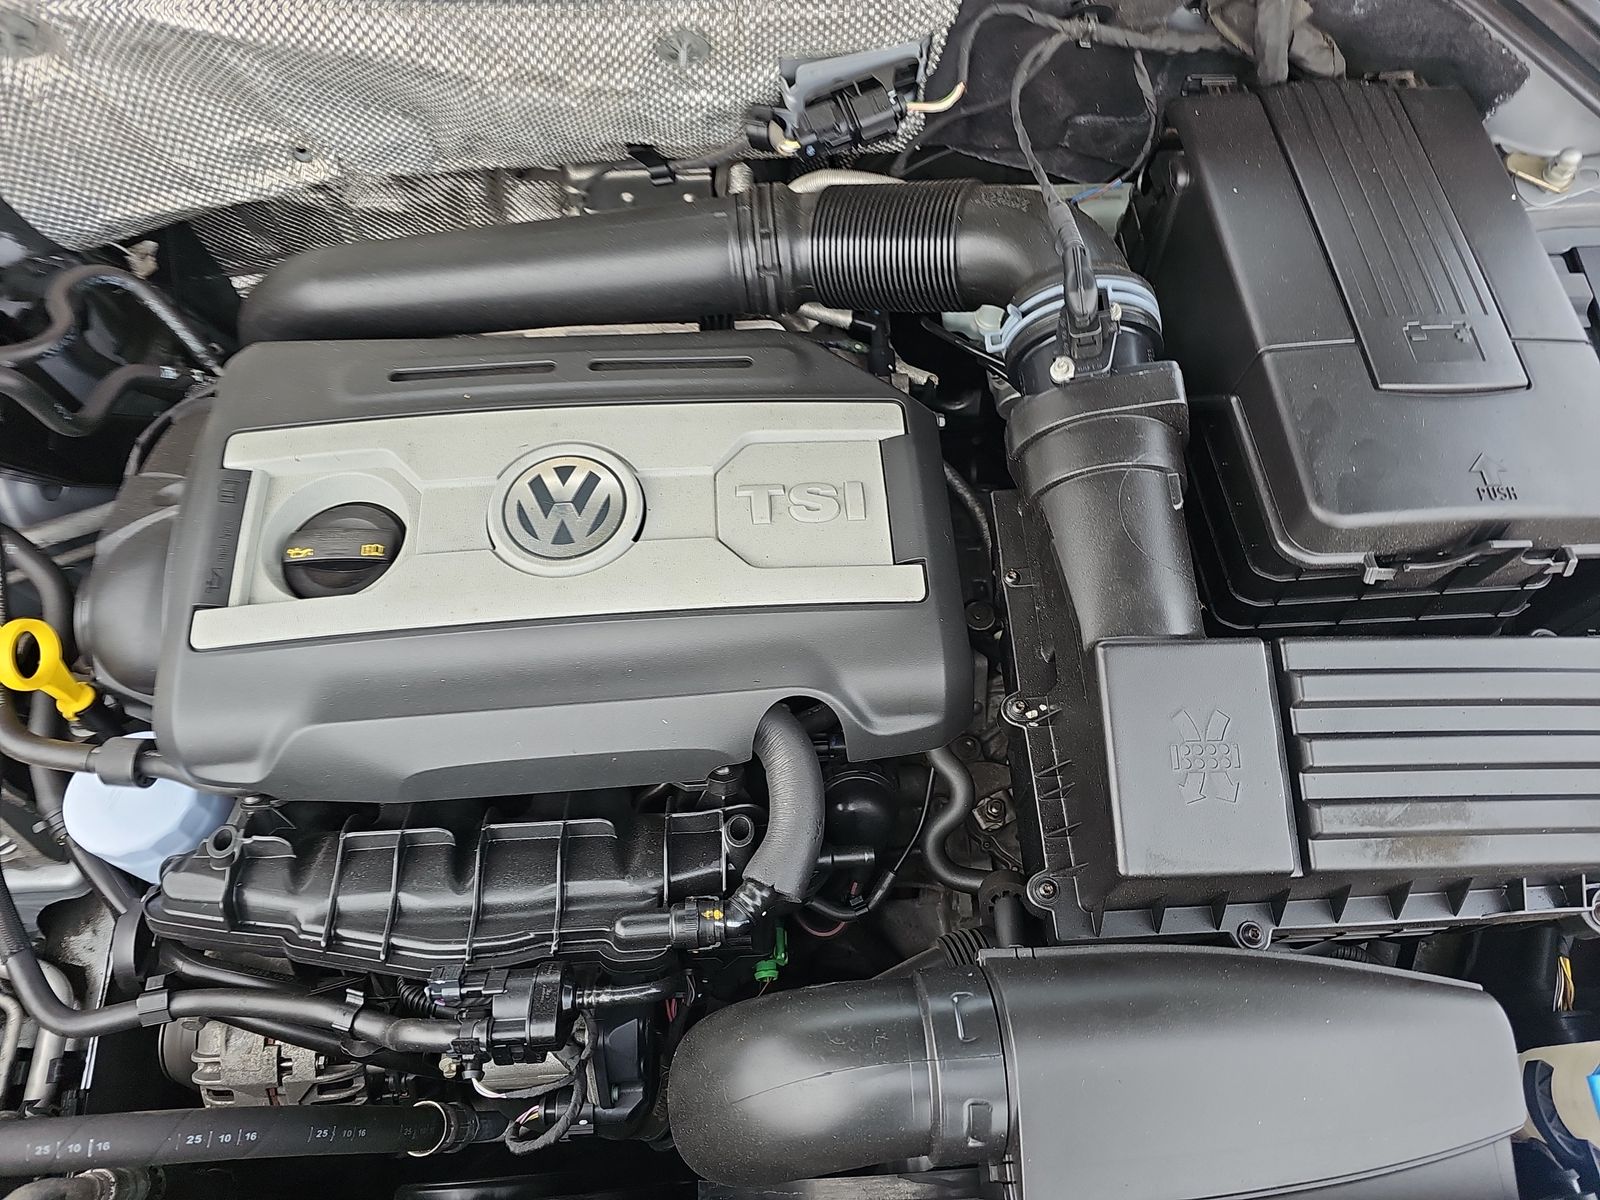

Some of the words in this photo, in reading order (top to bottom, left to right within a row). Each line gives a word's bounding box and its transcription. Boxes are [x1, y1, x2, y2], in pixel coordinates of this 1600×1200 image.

[1476, 486, 1518, 501] PUSH
[504, 455, 626, 560] VW
[734, 480, 867, 525] TSI
[185, 1134, 203, 1144] 25
[218, 1133, 232, 1143] 10
[244, 1132, 257, 1141] 16
[315, 1129, 329, 1138] 25
[34, 1145, 51, 1155] 25
[67, 1143, 82, 1153] 10
[95, 1141, 111, 1151] 16
